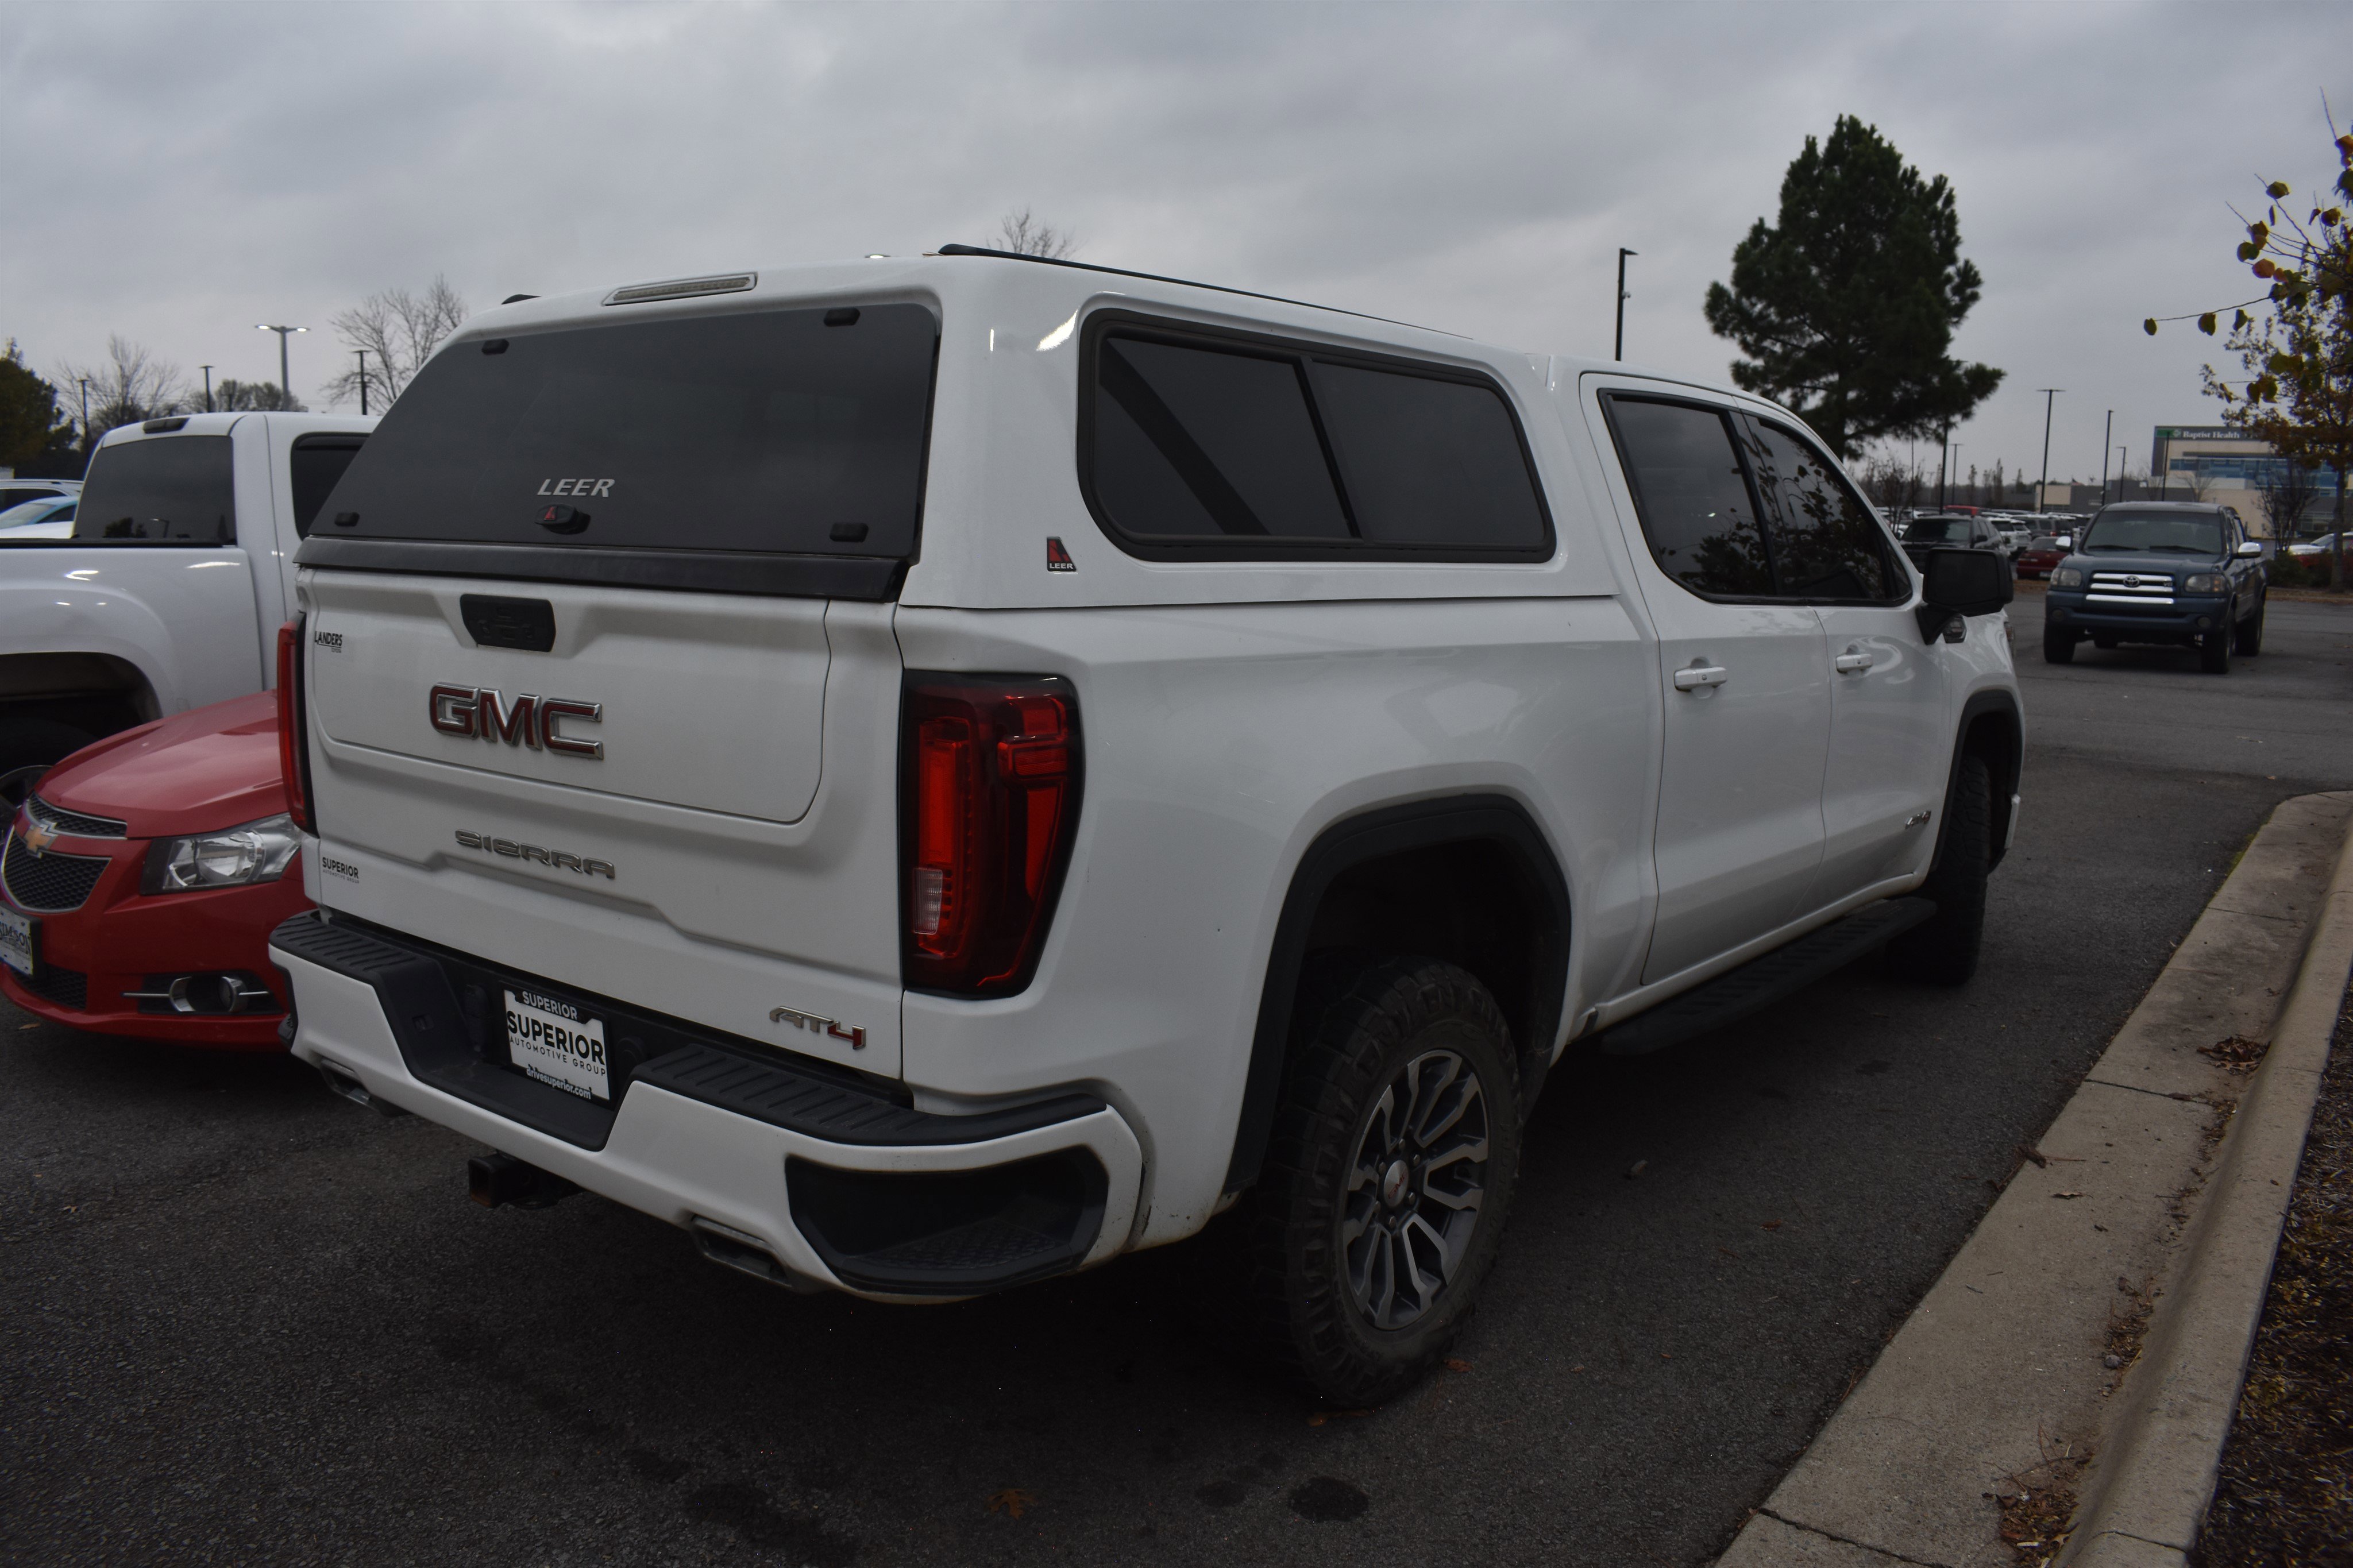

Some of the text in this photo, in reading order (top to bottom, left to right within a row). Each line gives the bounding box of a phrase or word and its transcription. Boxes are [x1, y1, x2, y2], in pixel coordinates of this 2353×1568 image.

[537, 478, 615, 497] LEER
[314, 631, 342, 647] LANDERS
[429, 682, 604, 759] GMC
[322, 856, 359, 879] SUPERIOR
[455, 828, 615, 879] SIERRA
[522, 991, 577, 1020] SUPERIOR
[507, 1011, 605, 1065] SUPERIOR
[769, 1006, 866, 1049] AT4
[510, 1036, 605, 1076] AUTOMOTIVE GROUP
